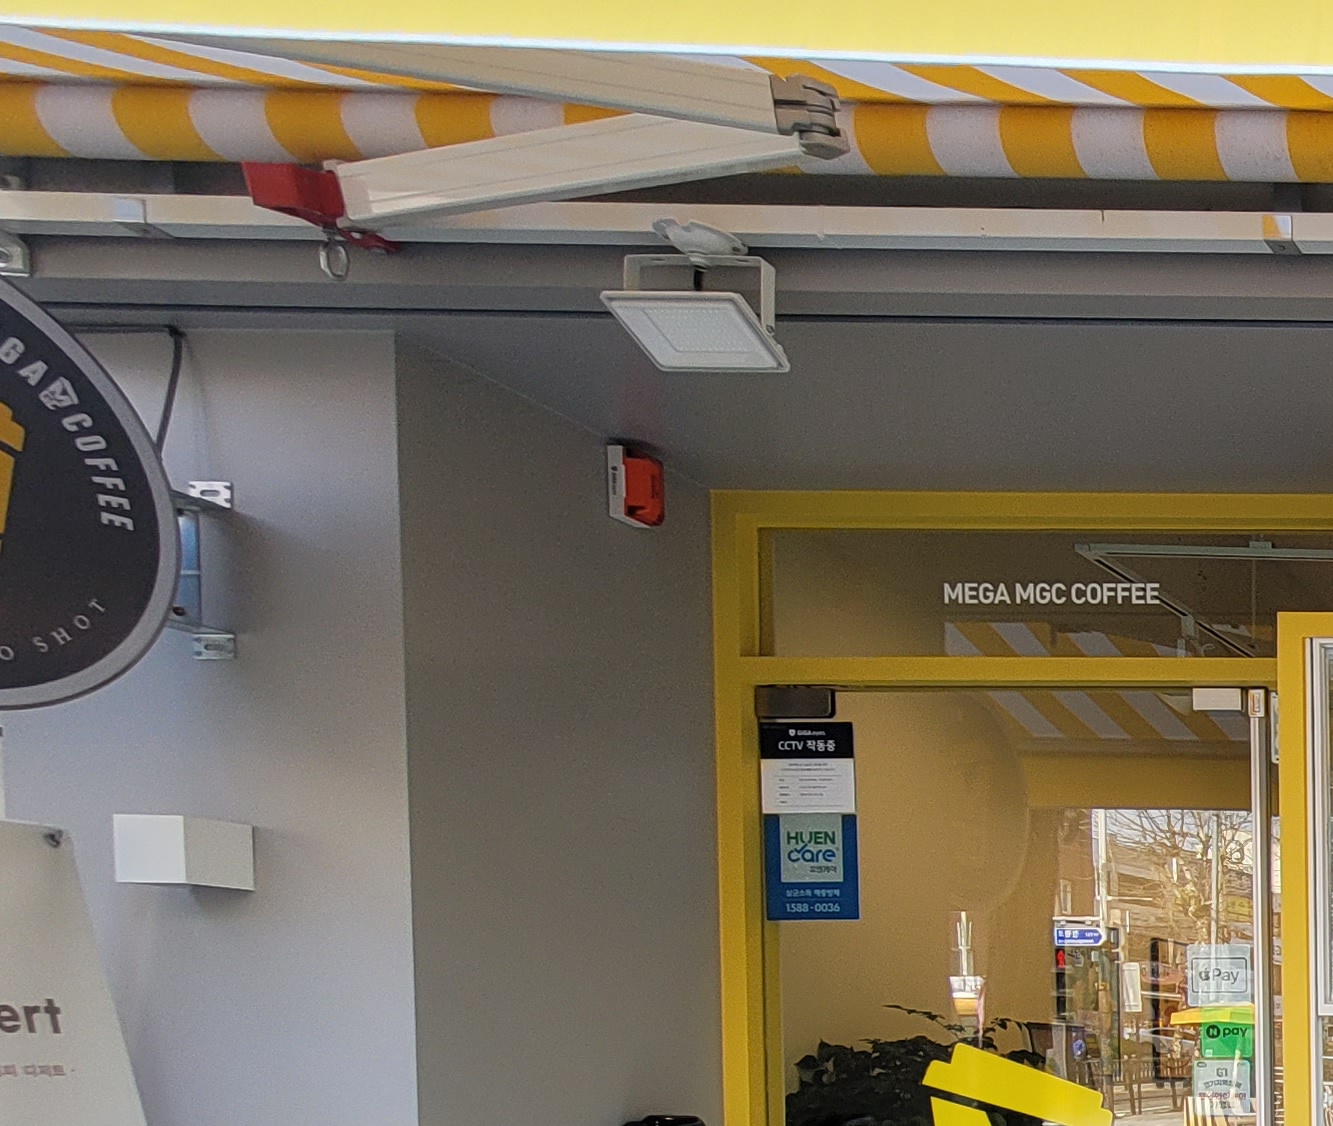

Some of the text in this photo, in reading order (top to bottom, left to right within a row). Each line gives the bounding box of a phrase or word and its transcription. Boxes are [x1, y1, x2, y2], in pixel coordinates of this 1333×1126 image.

[61, 412, 135, 532] COFFEE
[943, 583, 1160, 604] MEGA MGC COFFEE
[32, 598, 106, 653] SHOT
[778, 739, 836, 752] CCTV 작동중
[786, 830, 836, 845] HUEN
[1212, 967, 1239, 984] Pay
[1222, 1026, 1248, 1038] pay
